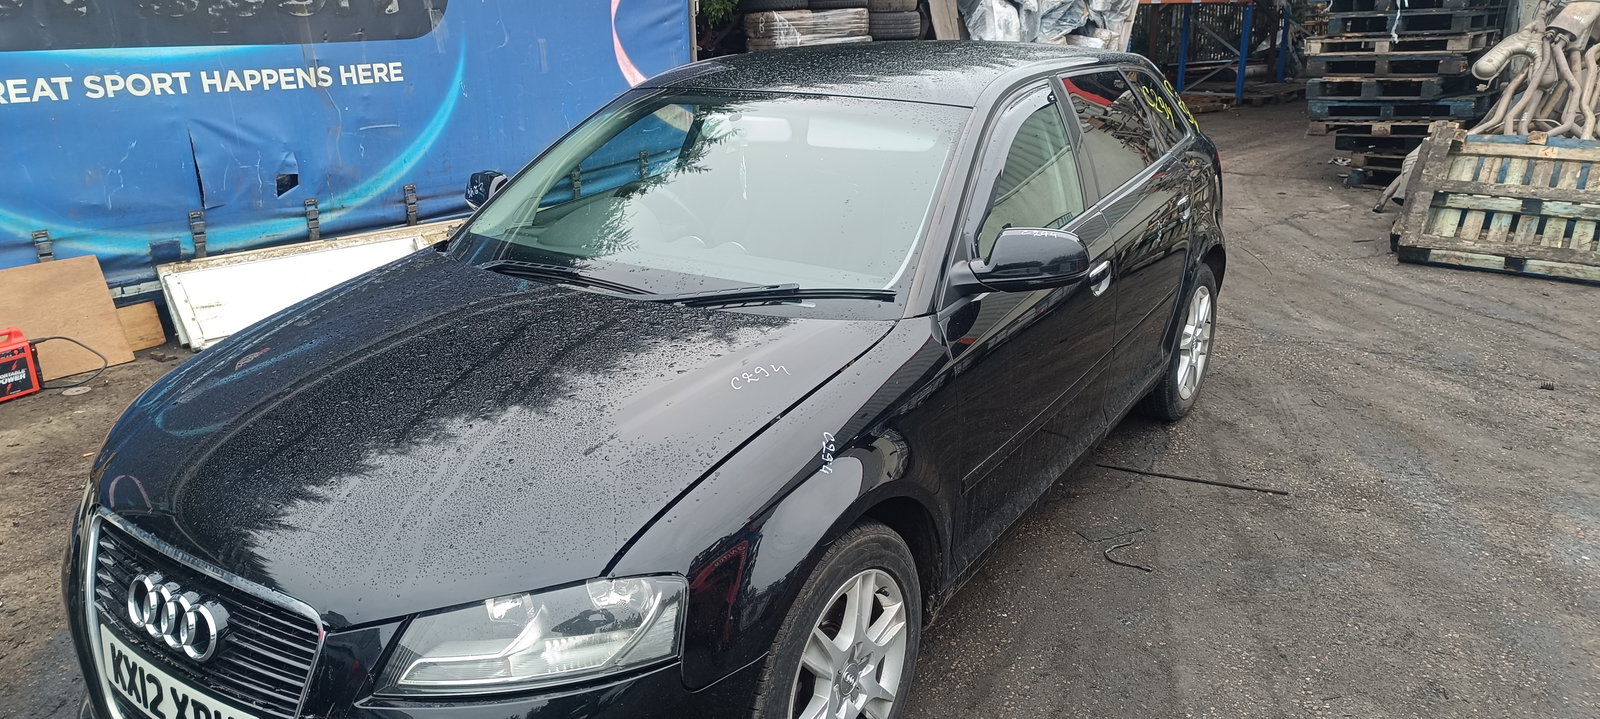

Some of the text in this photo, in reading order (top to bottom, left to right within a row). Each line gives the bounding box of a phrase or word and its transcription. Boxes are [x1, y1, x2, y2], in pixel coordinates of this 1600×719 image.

[83, 71, 192, 99] SPORT
[200, 66, 333, 94] HAPPENS
[339, 62, 404, 86] HERE
[730, 364, 791, 390] C294
[819, 431, 836, 474] C294
[110, 642, 167, 719] KX12
